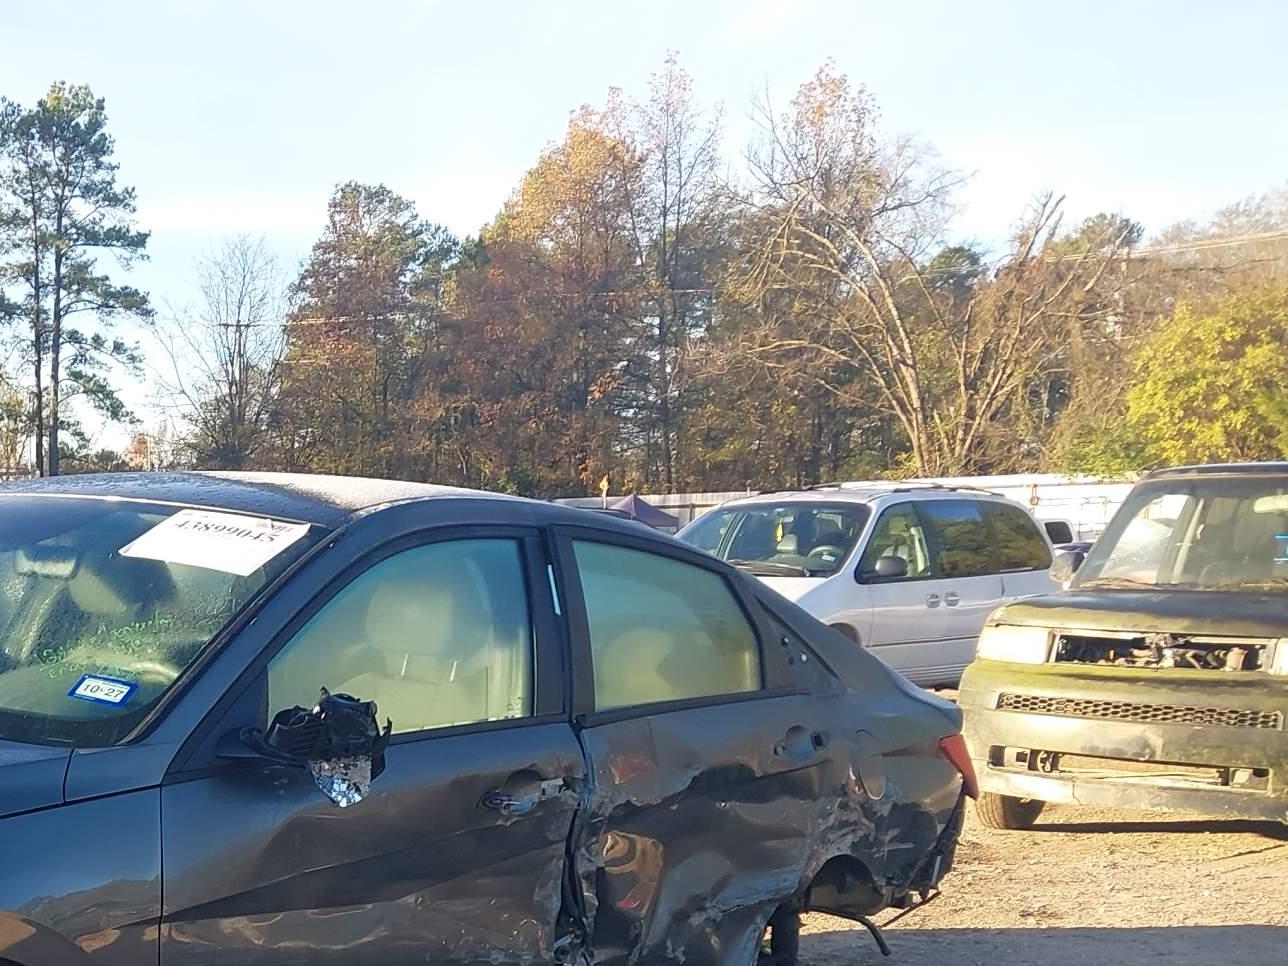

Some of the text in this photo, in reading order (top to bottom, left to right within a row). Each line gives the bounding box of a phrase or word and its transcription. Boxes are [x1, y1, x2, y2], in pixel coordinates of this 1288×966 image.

[173, 520, 281, 543] 43899045
[83, 683, 124, 698] 10 27
